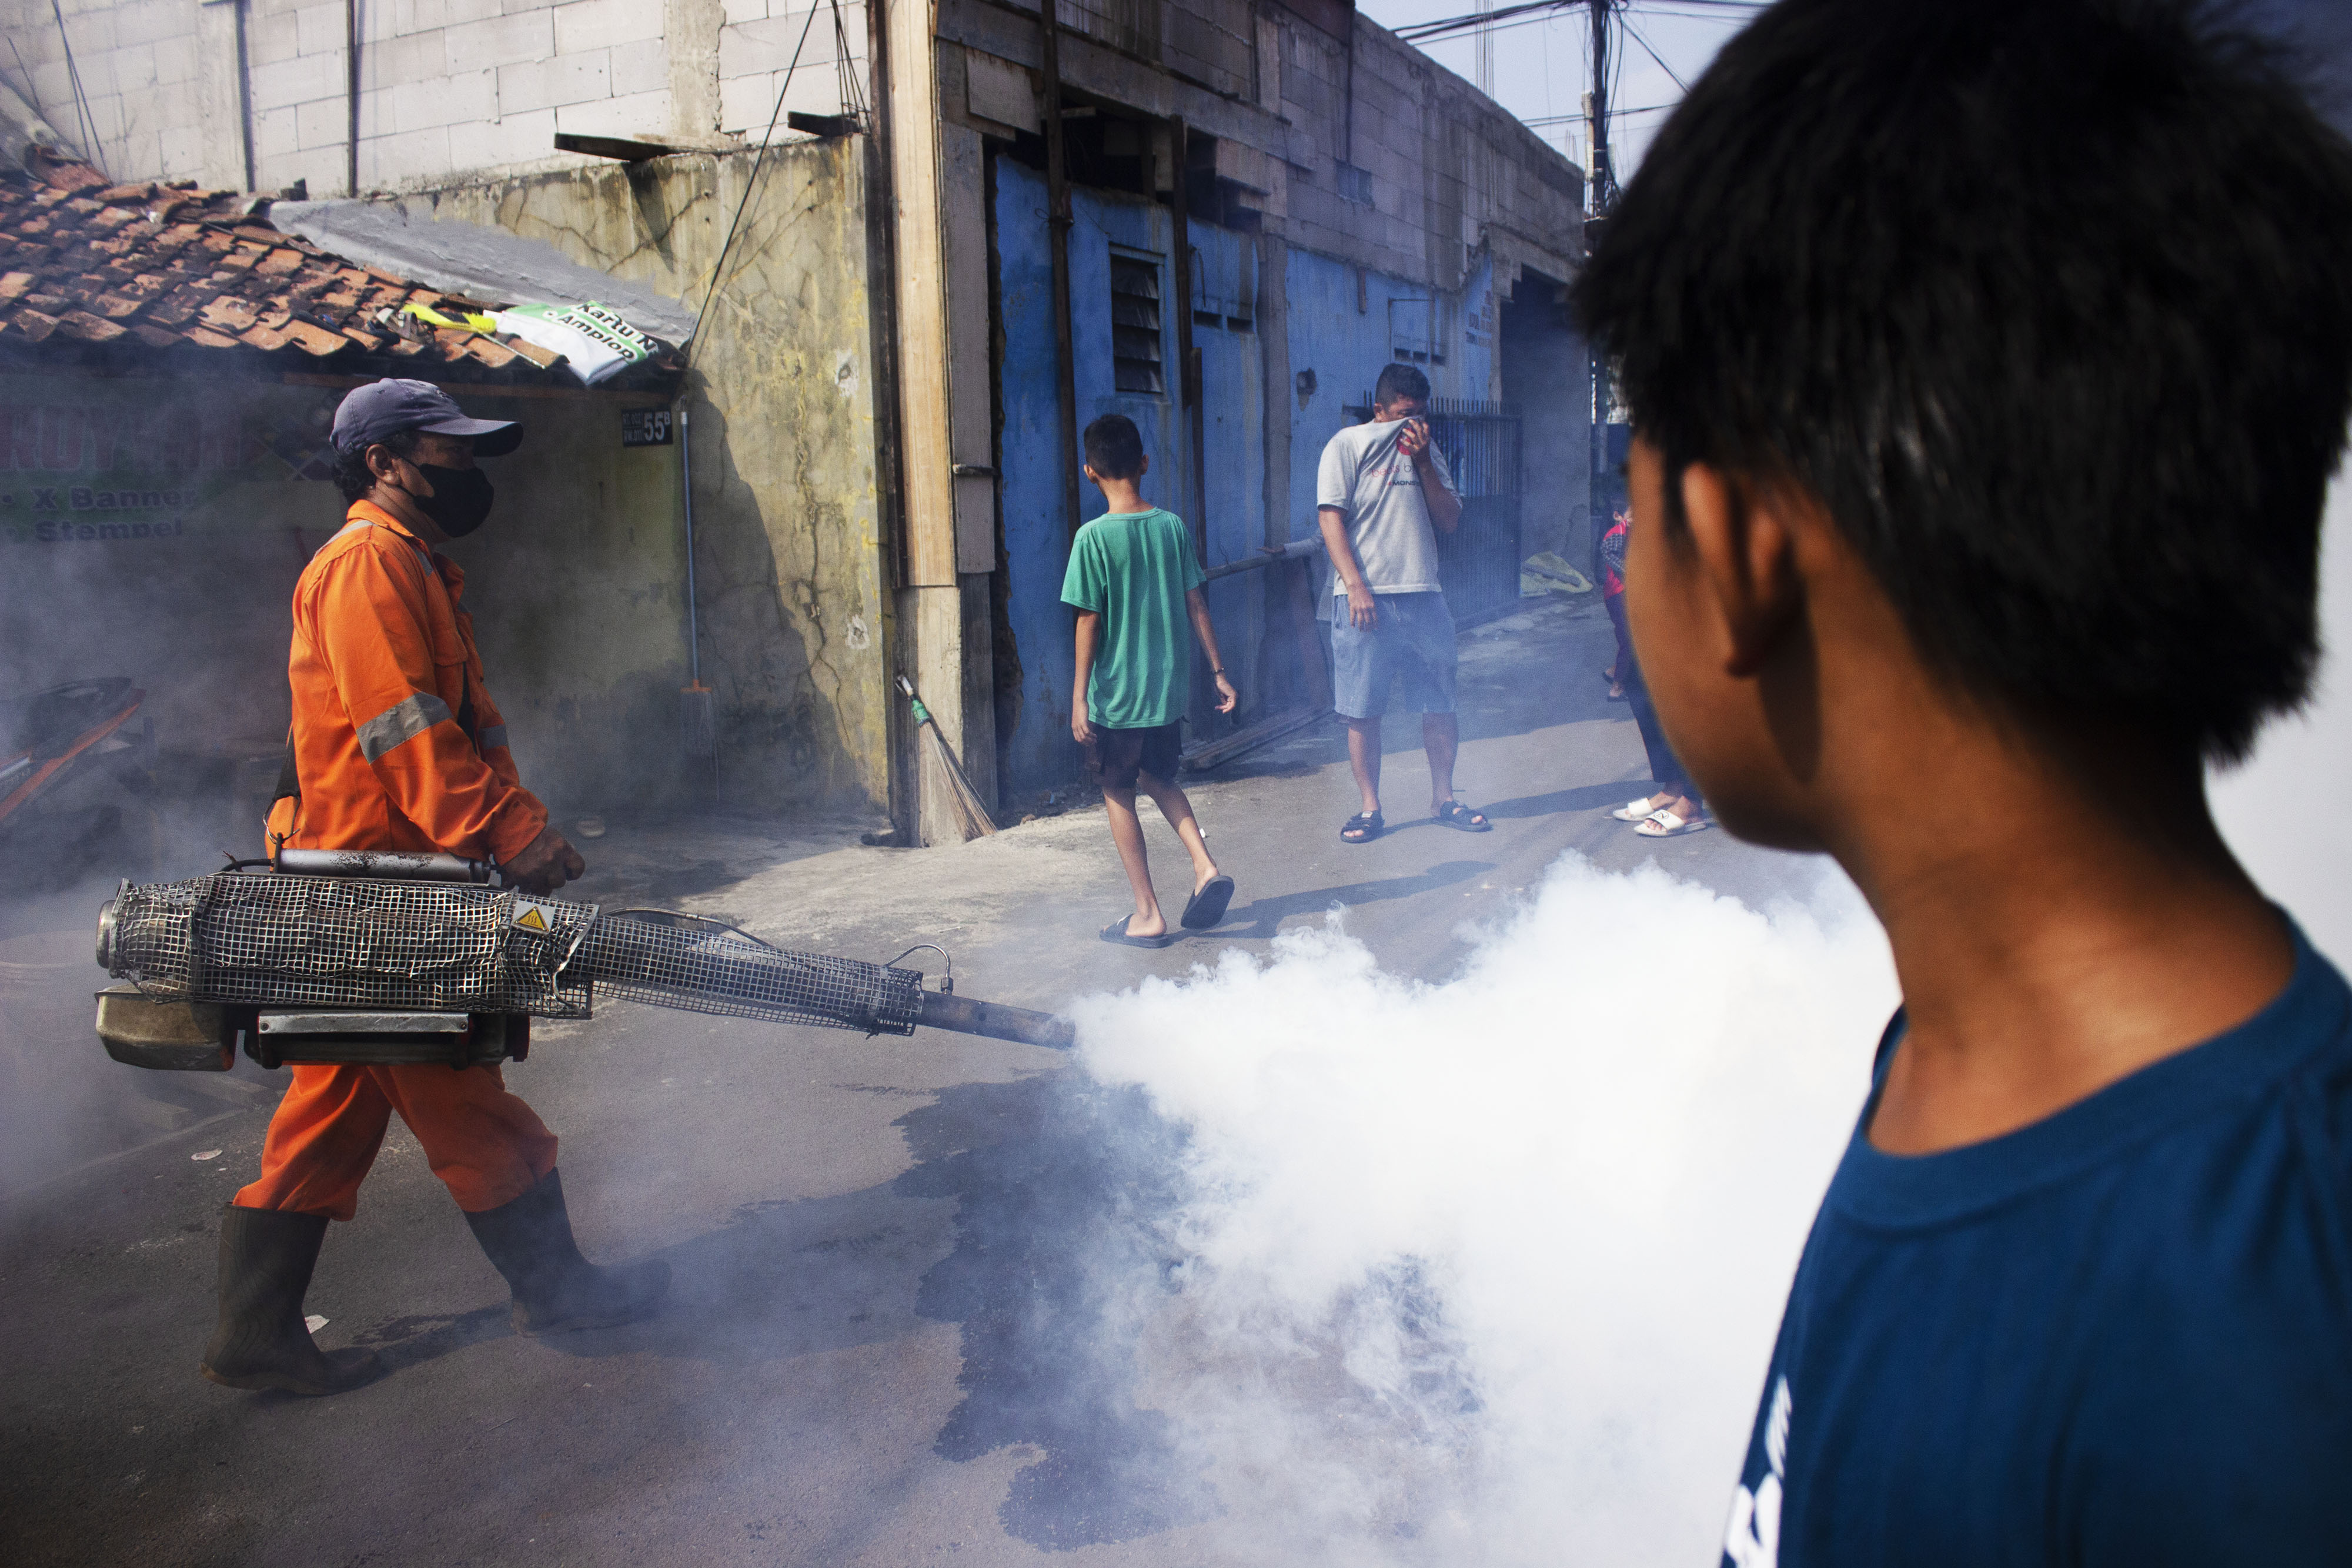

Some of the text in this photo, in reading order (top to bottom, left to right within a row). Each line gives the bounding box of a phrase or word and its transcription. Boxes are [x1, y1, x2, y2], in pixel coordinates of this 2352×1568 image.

[557, 314, 634, 359] Amplop
[576, 303, 634, 337] Kartu
[32, 487, 198, 510] X Banner
